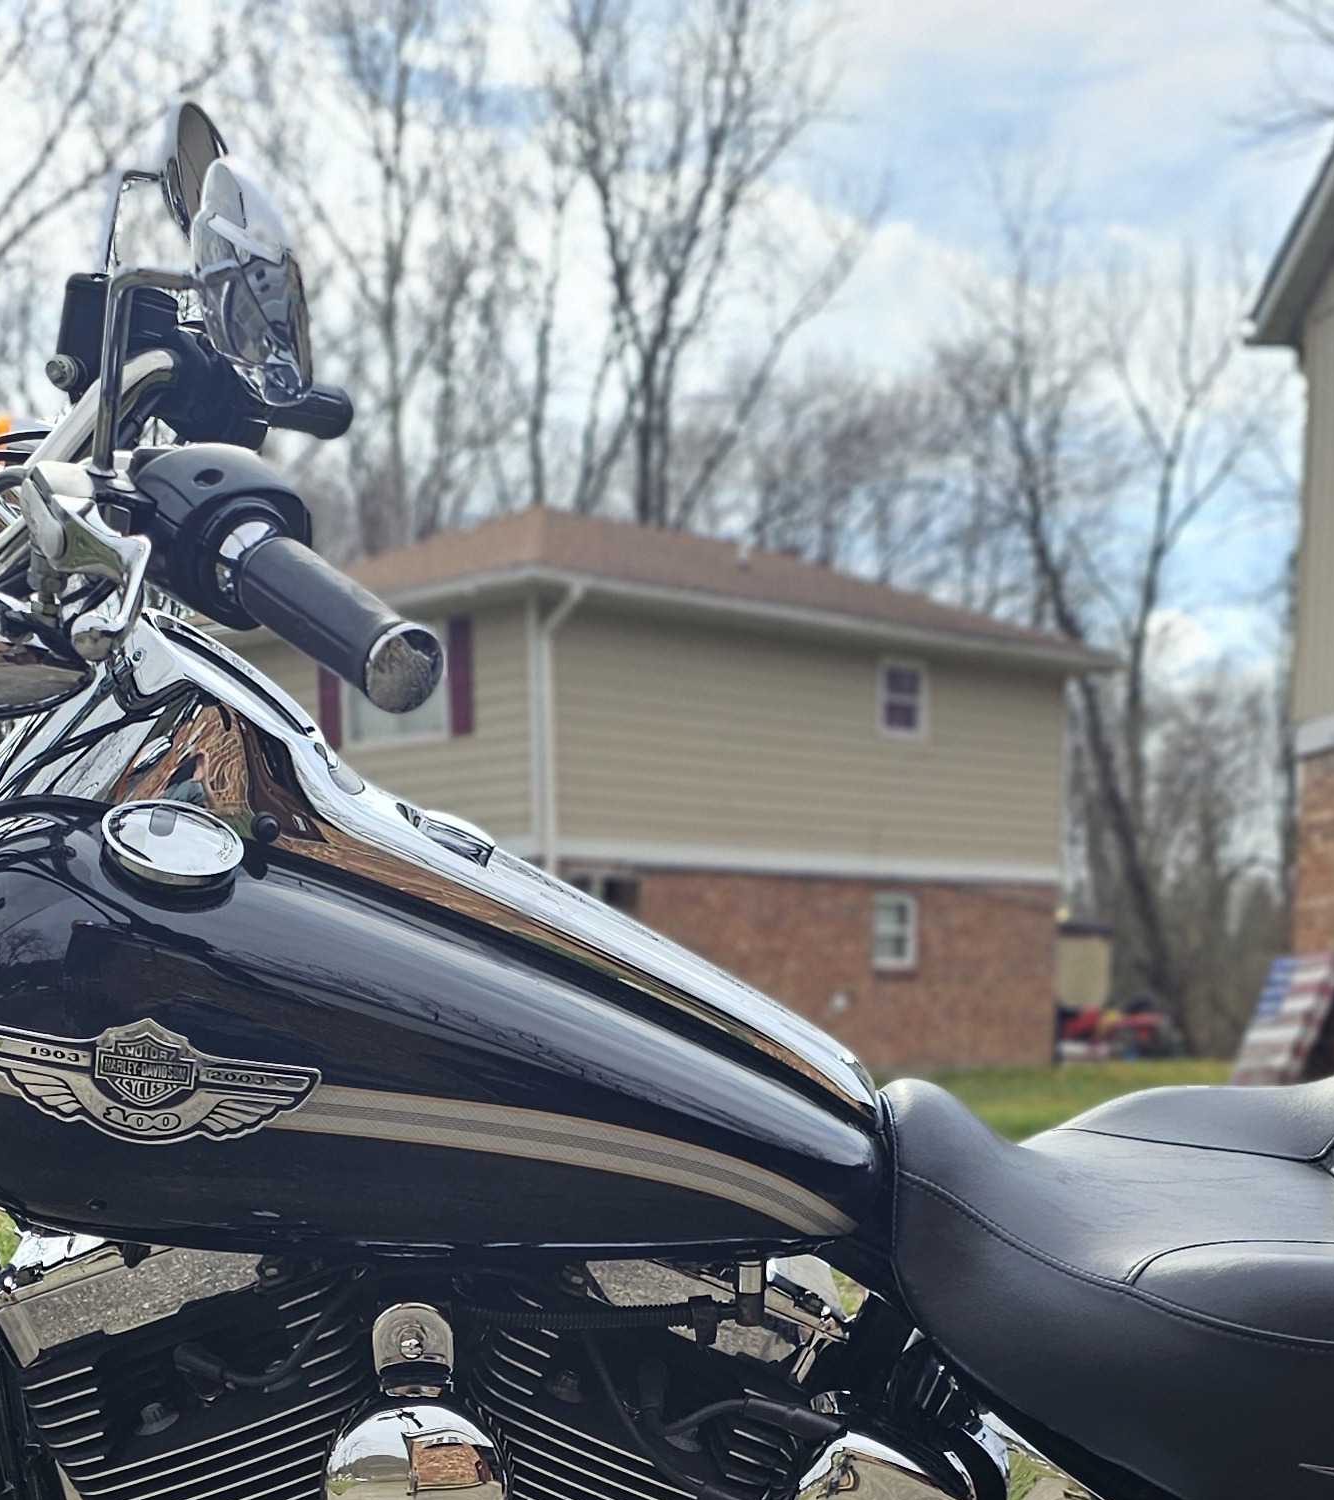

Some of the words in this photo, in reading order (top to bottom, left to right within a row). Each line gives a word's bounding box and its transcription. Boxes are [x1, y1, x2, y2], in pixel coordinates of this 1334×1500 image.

[29, 1046, 81, 1063] 1903
[124, 1042, 168, 1061] MOTOR
[104, 1057, 187, 1081] HARLEY-DAVIDSON
[208, 1070, 266, 1086] 2003
[121, 1079, 165, 1099] CYCLES
[102, 1106, 181, 1131] 100
